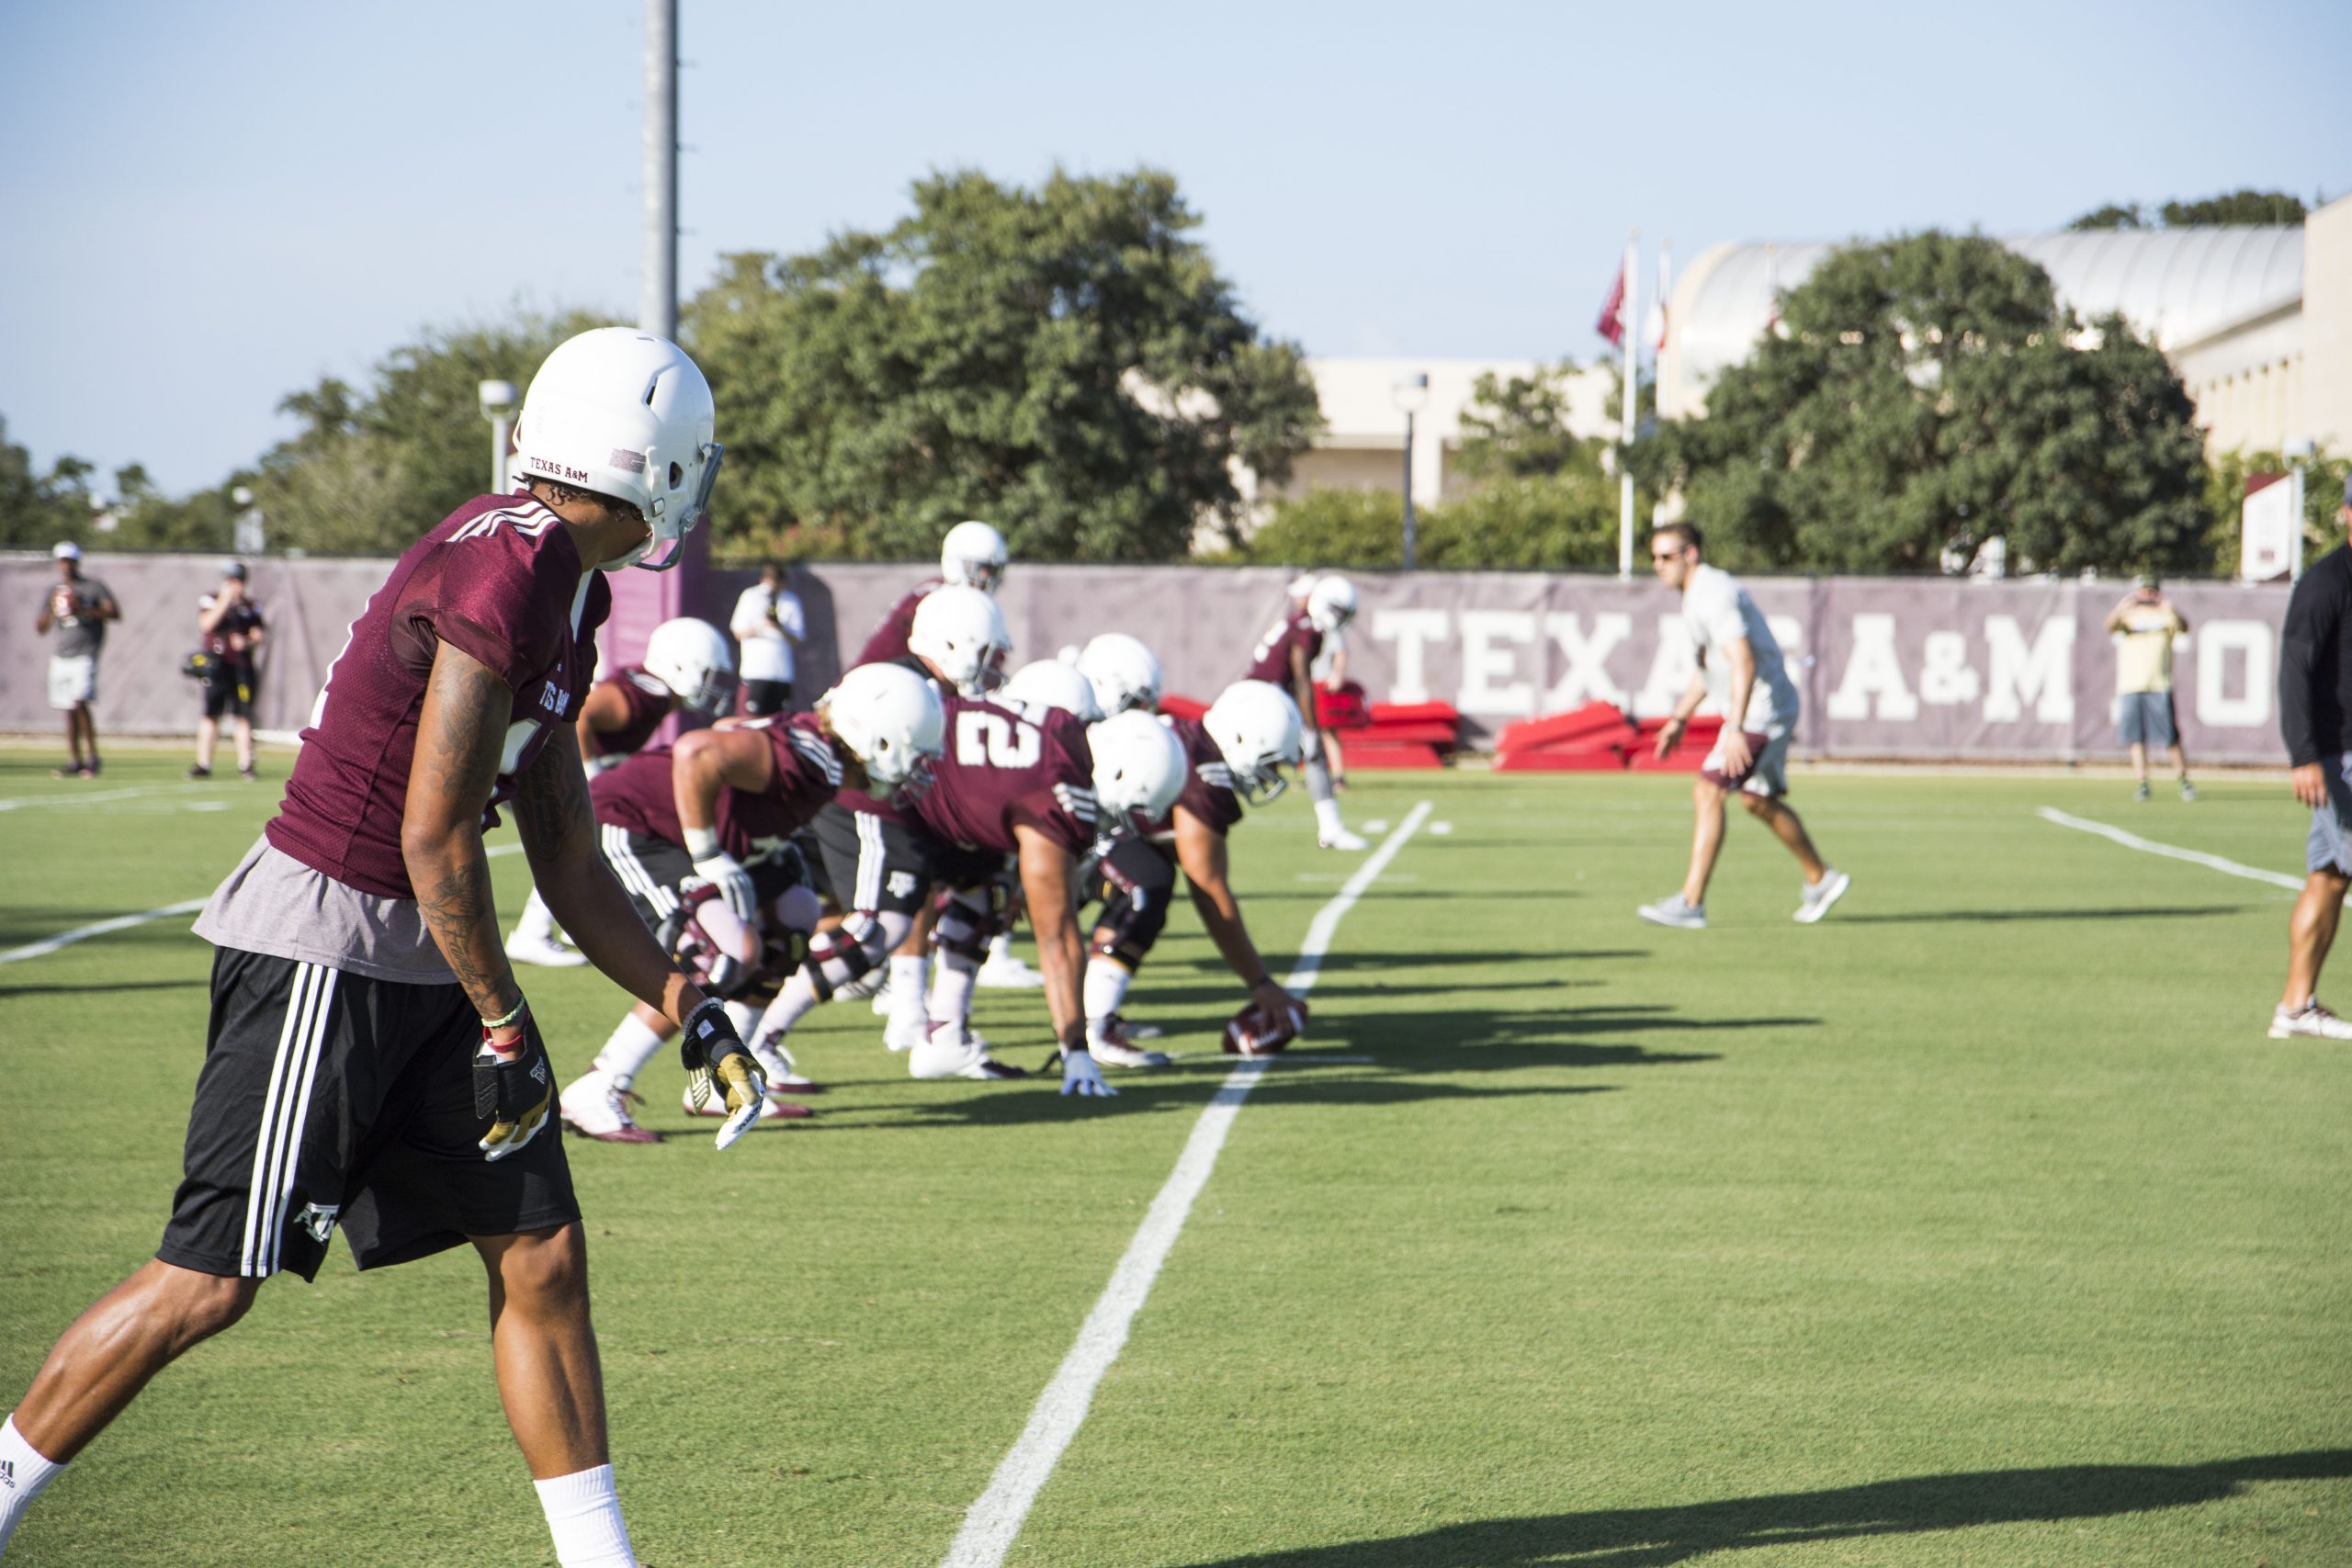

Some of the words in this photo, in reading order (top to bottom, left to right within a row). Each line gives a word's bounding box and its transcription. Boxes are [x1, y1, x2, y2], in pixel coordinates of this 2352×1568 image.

[530, 457, 561, 475] TEXAS
[565, 467, 588, 483] A&M
[1826, 613, 2077, 723] A&M
